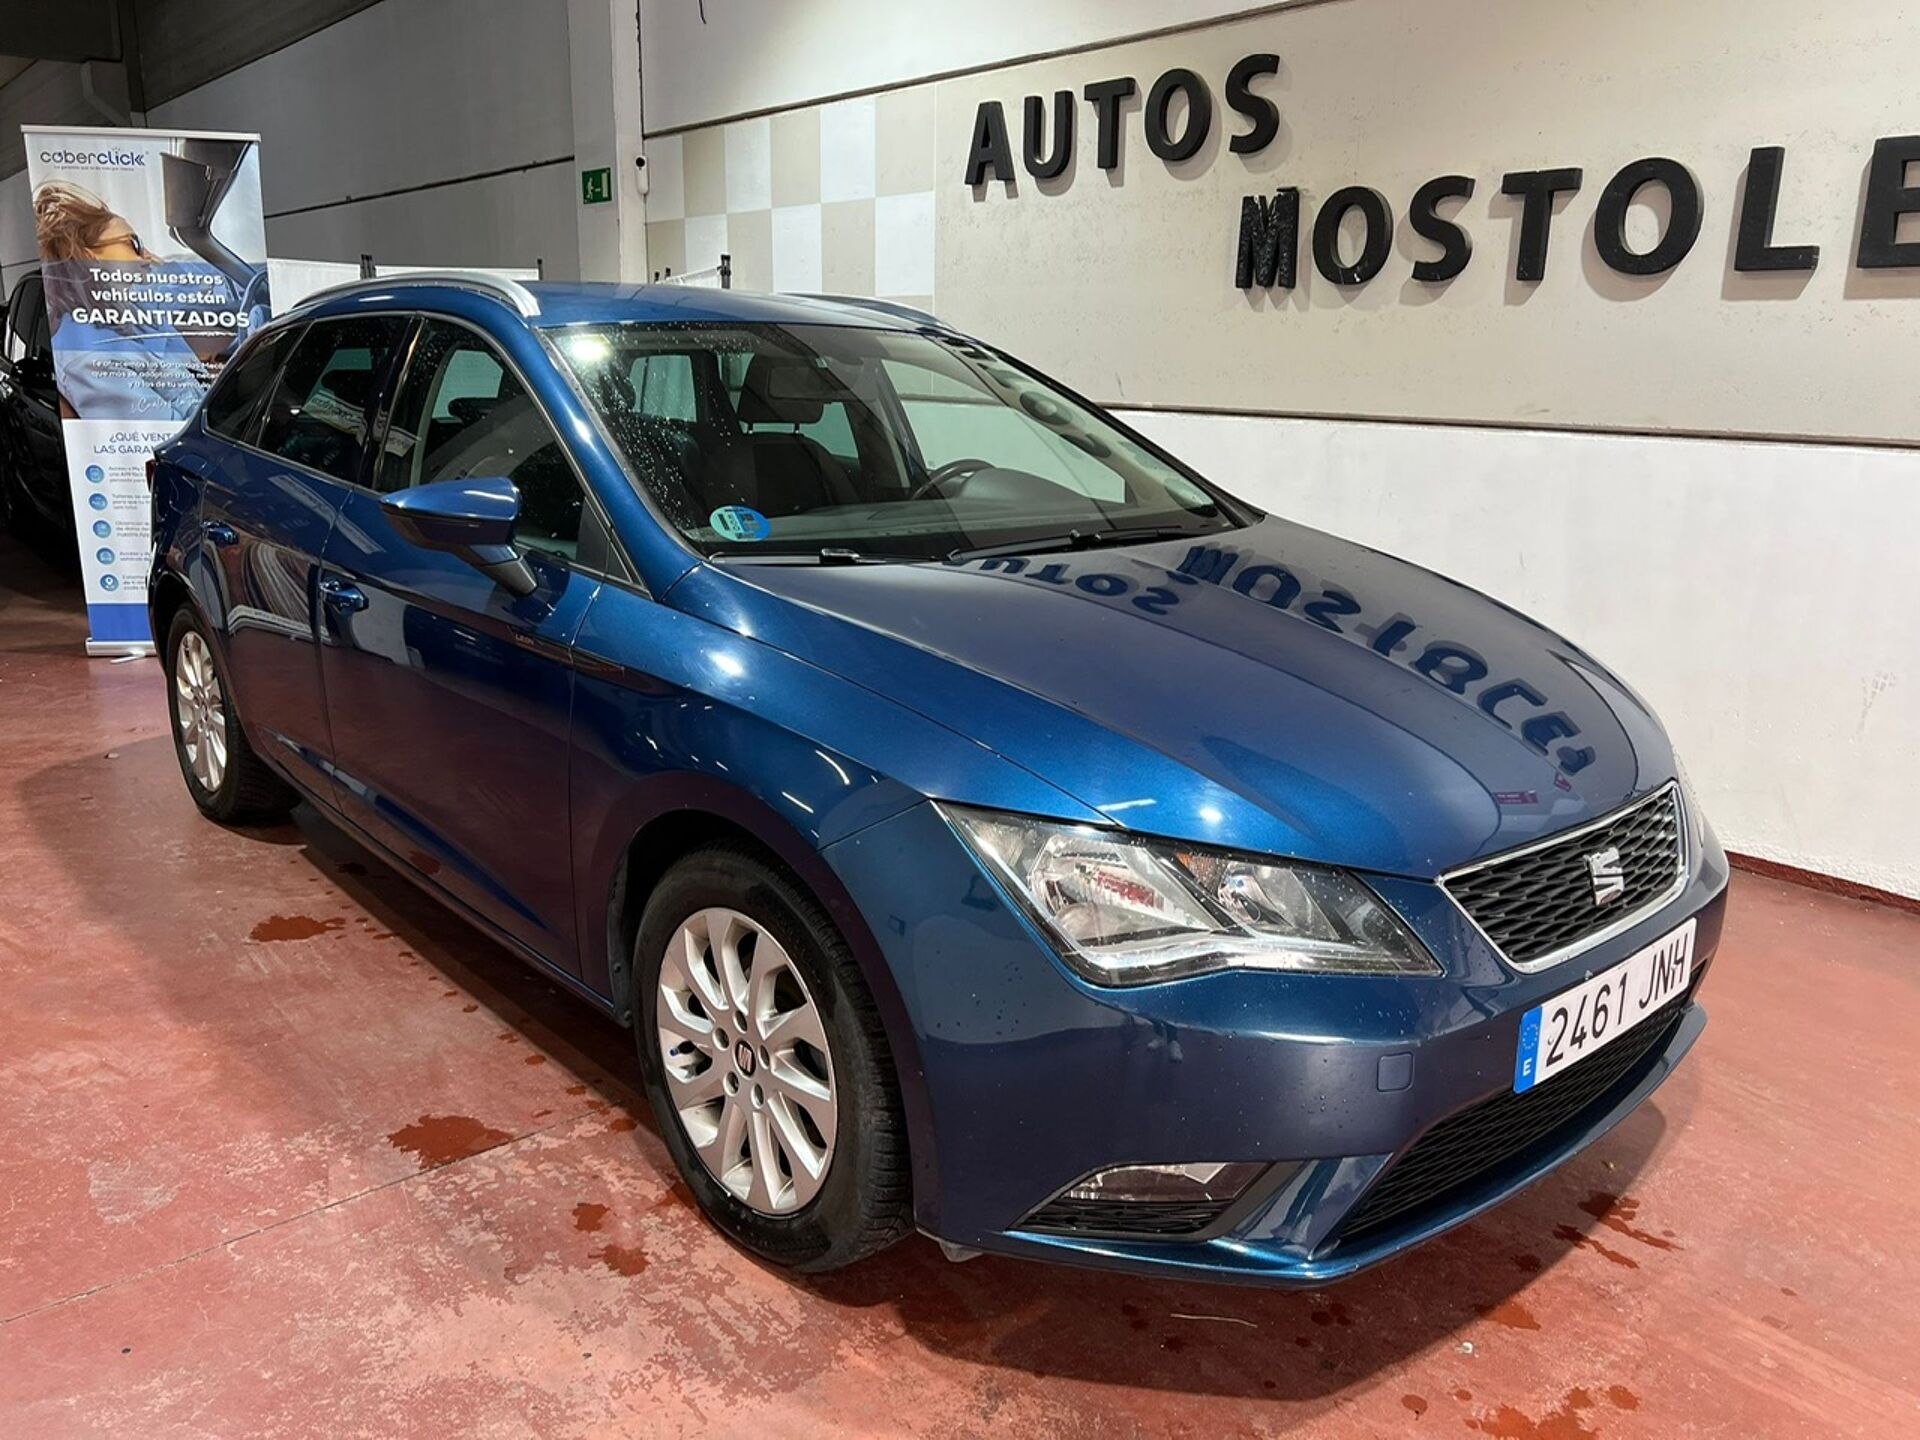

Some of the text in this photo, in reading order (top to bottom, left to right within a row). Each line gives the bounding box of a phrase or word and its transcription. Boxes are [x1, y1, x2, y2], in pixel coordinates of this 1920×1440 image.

[964, 53, 1280, 186] AUTOS
[1235, 136, 1920, 290] MOSTOLE
[89, 268, 223, 285] Todos nuestros
[91, 287, 226, 305] vehículos están
[72, 307, 250, 328] GARANTIZADOS
[109, 430, 140, 443] ¿QUÉ
[94, 445, 116, 454] LAS
[1545, 932, 1689, 1068] 2461 JNH
[1522, 1057, 1533, 1077] E
